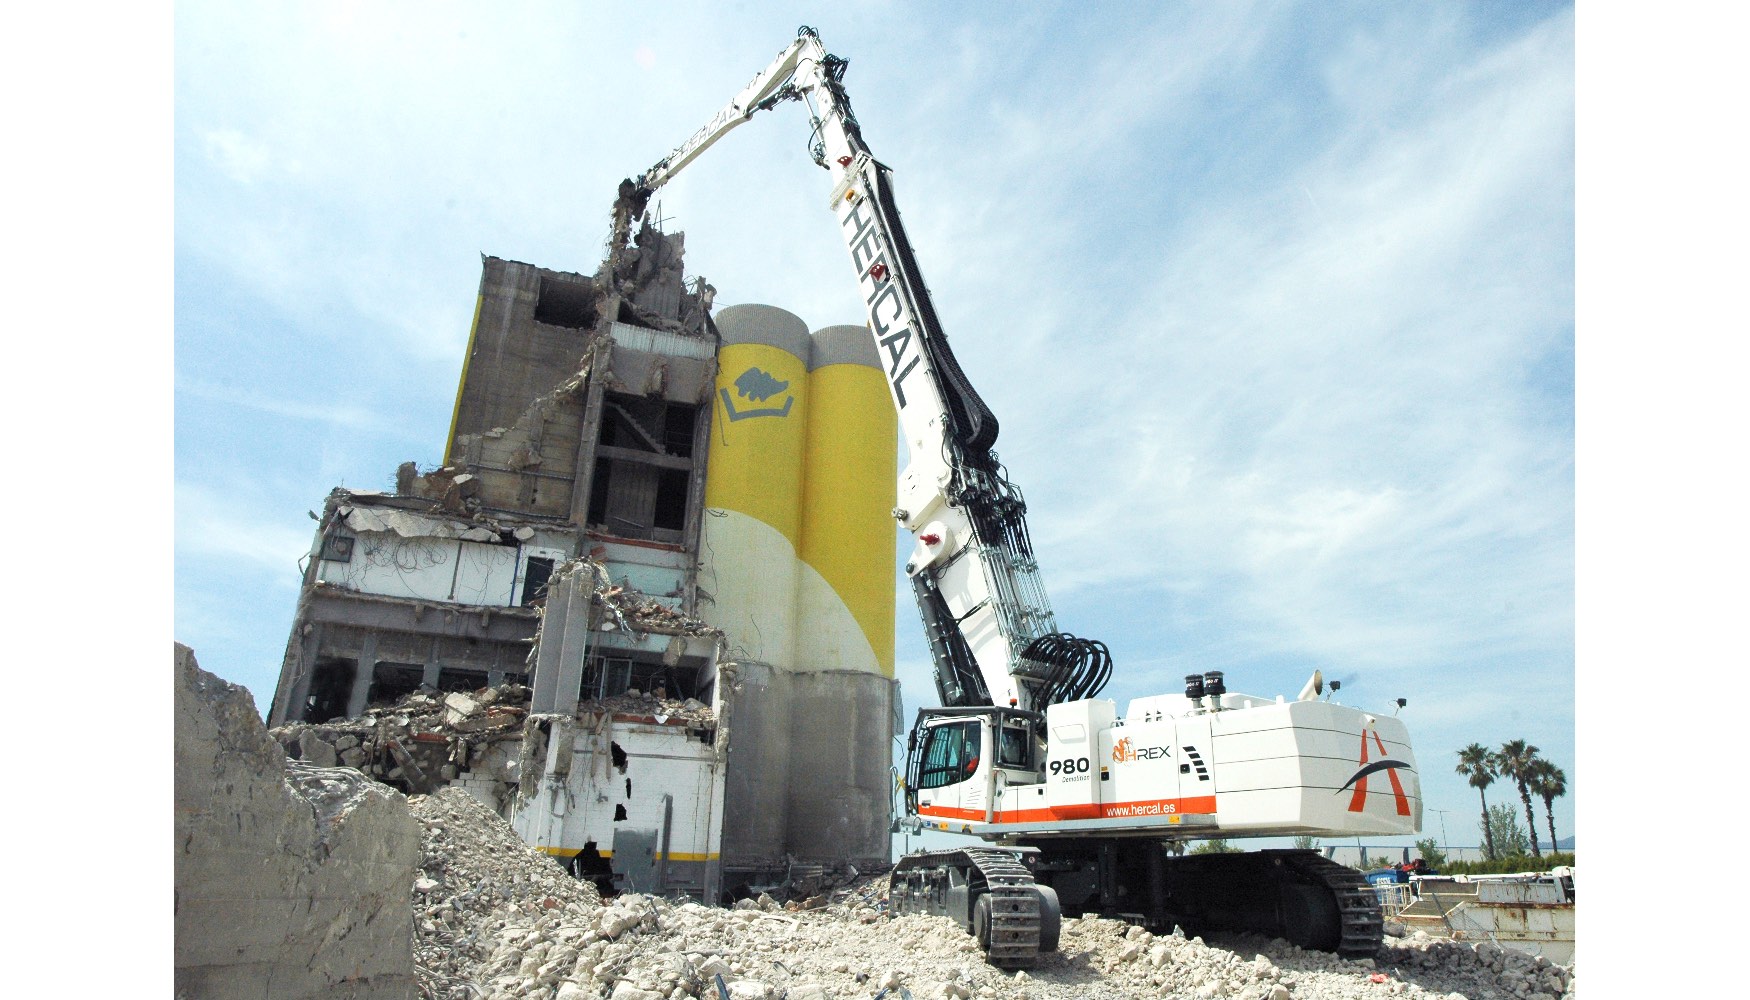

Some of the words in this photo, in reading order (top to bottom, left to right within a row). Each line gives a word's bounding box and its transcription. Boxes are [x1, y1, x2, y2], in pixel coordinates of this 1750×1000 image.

[842, 206, 920, 410] HERCAL
[1049, 757, 1090, 776] 980
[1106, 802, 1176, 817] www.hercal.es
